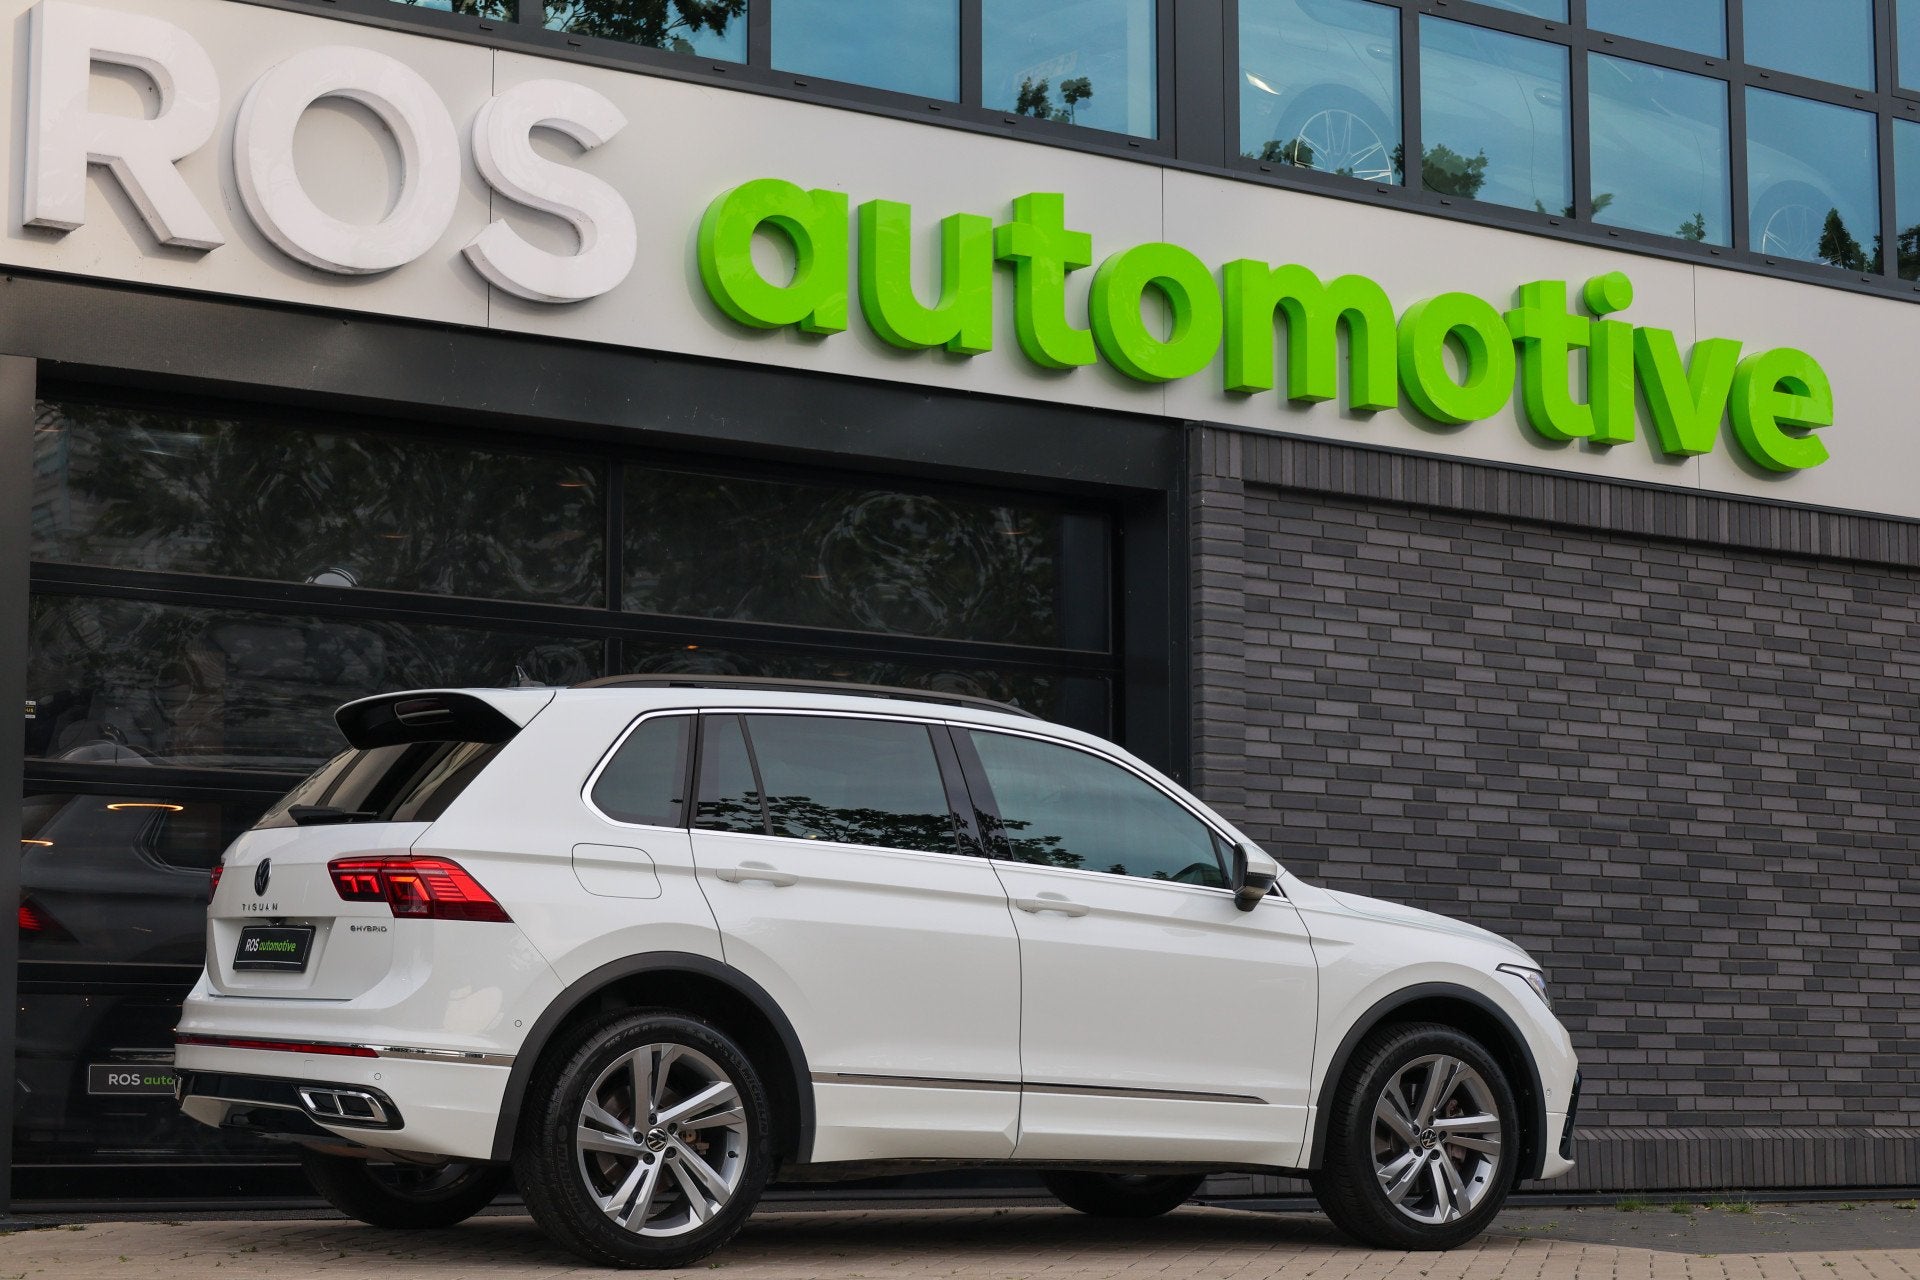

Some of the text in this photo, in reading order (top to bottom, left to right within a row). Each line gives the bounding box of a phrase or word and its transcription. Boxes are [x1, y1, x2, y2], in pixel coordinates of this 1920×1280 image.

[22, 0, 1834, 474] ROS automotive
[244, 938, 297, 952] ROS automotive
[108, 1073, 140, 1085] ROS
